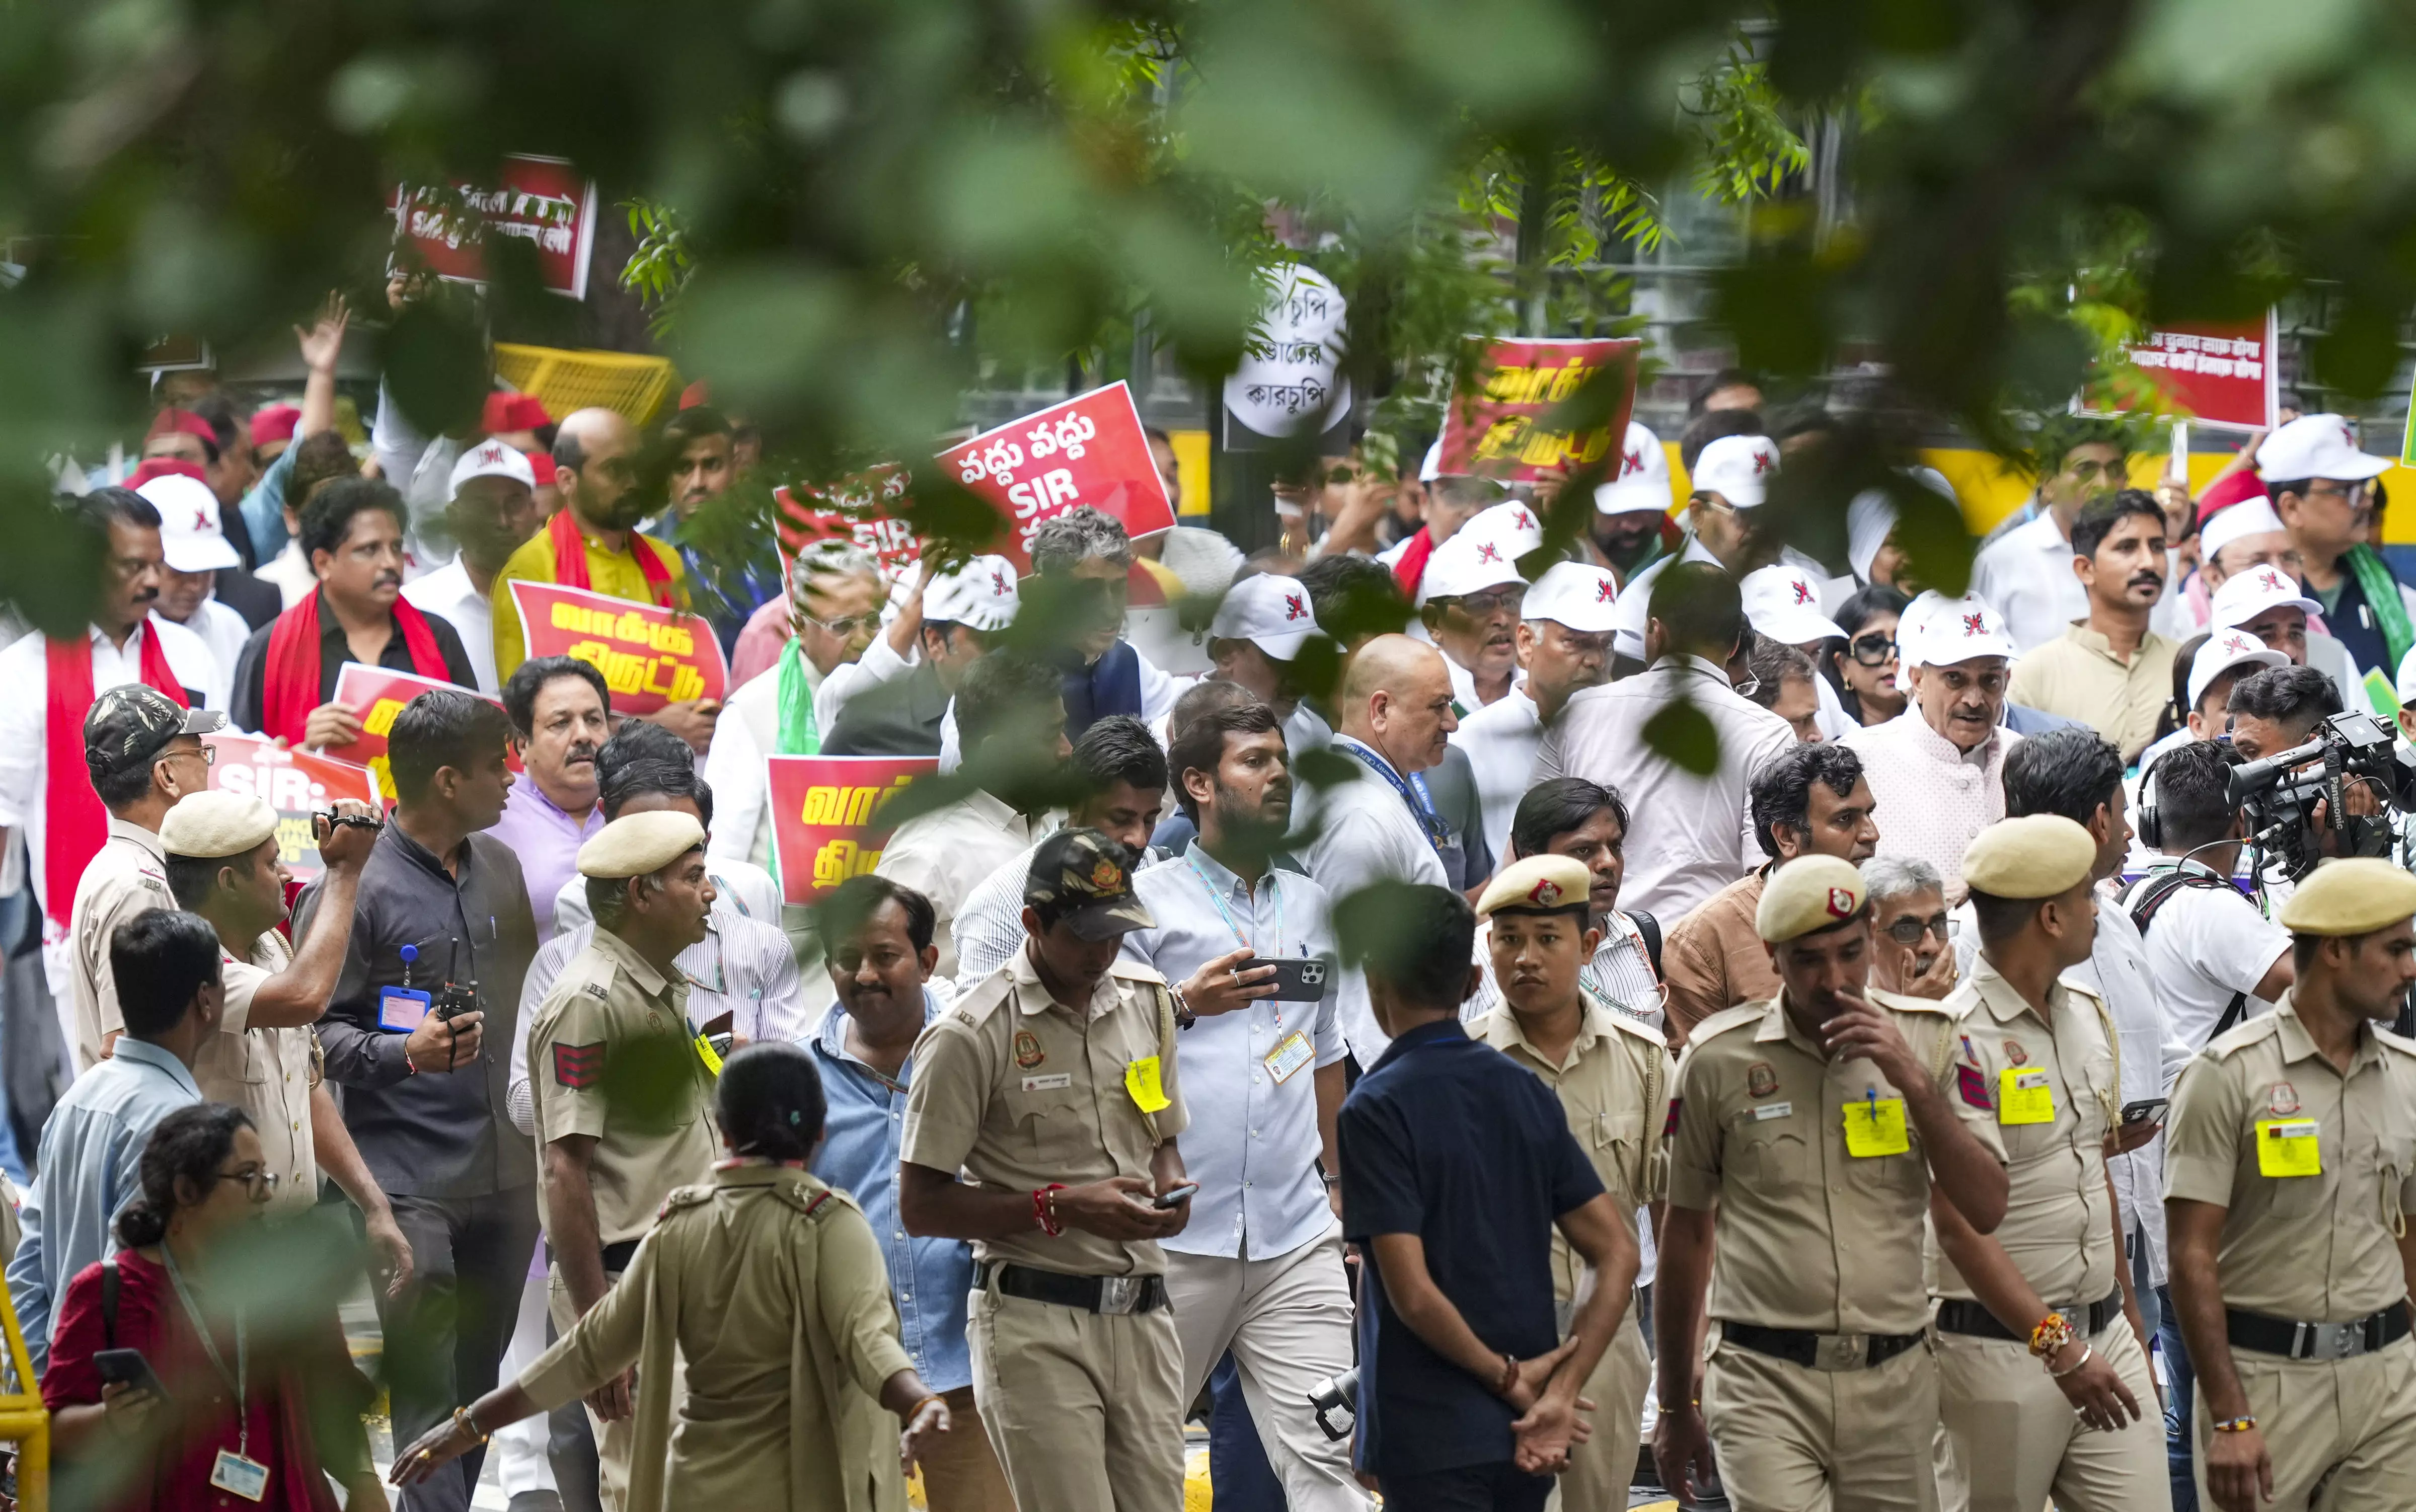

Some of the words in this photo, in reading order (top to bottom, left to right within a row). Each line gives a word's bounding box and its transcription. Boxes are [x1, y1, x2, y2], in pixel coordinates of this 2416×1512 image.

[1008, 468, 1080, 519] SIR
[852, 518, 918, 554] SIR
[551, 601, 694, 657] வாக்கு
[1376, 763, 1397, 785] Security
[1396, 783, 1405, 794] VIP
[2329, 776, 2345, 830] Panasonic
[1598, 991, 1609, 1002] INDIA
[1612, 1002, 1636, 1014] PARLIAMENT
